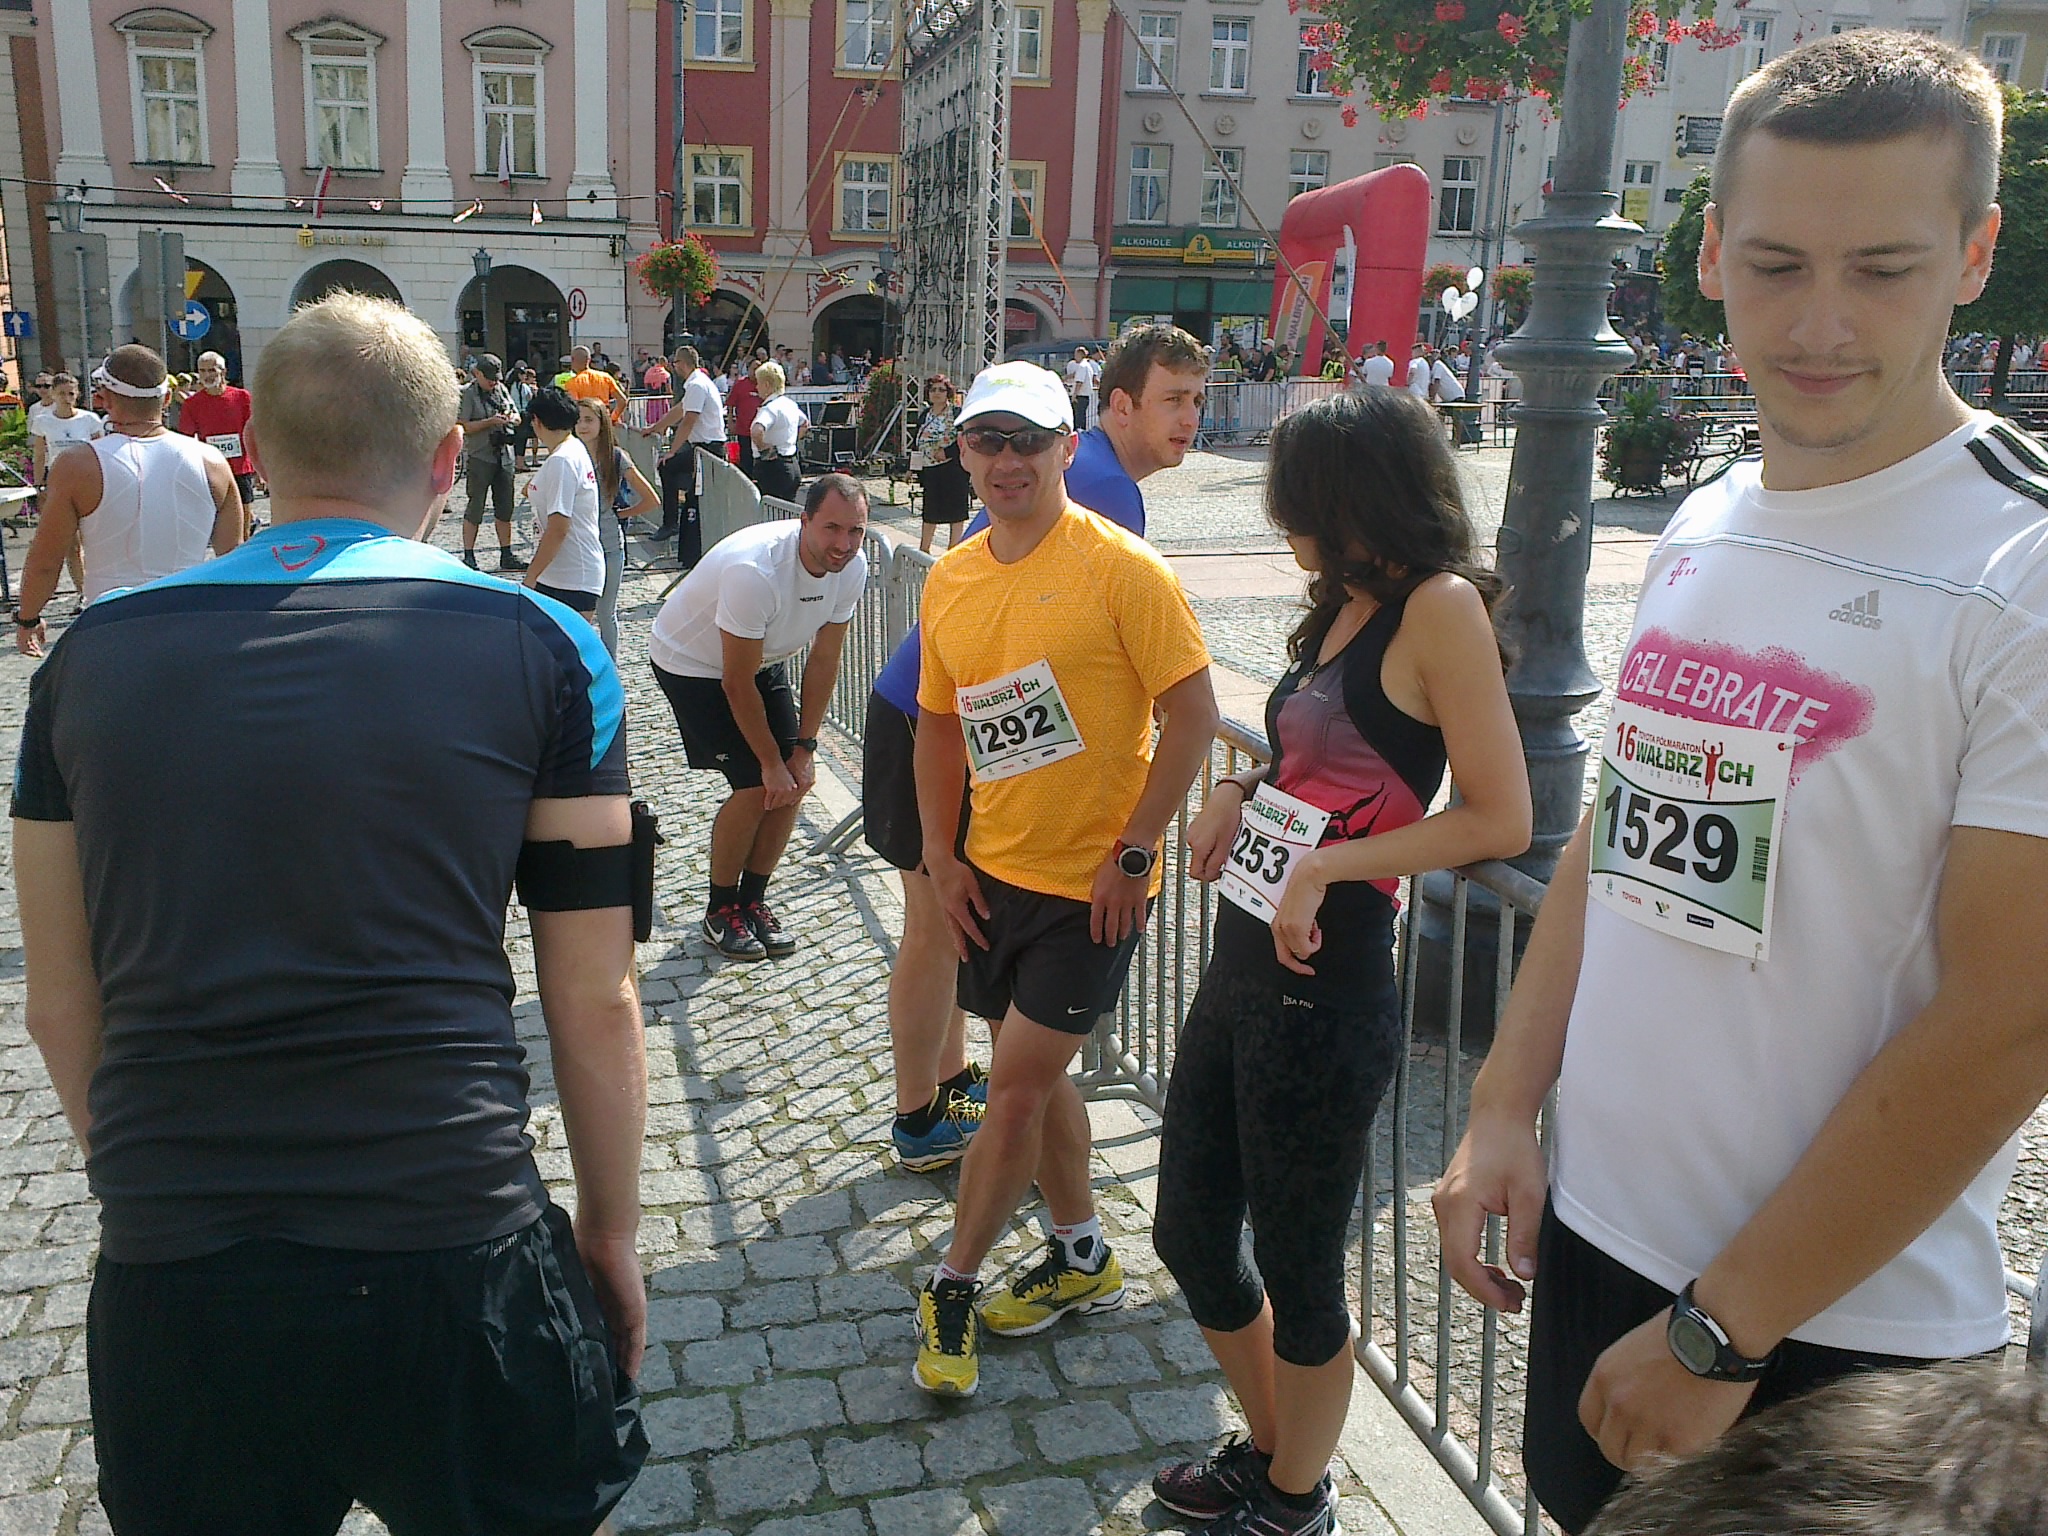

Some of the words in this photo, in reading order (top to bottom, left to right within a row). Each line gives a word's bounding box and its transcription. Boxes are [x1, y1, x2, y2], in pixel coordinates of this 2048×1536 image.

[1120, 238, 1172, 247] ALKOHOLE
[1226, 241, 1259, 249] ALKOH
[1828, 607, 1883, 630] adidas
[961, 695, 973, 713] 16
[1622, 650, 1831, 742] CELEBRATE
[970, 704, 1057, 754] 1292
[1617, 721, 1638, 761] 16
[1656, 735, 1701, 753] PÓŁMARATON
[1604, 785, 1739, 883] 1529
[1622, 891, 1642, 906] TOYOTA
